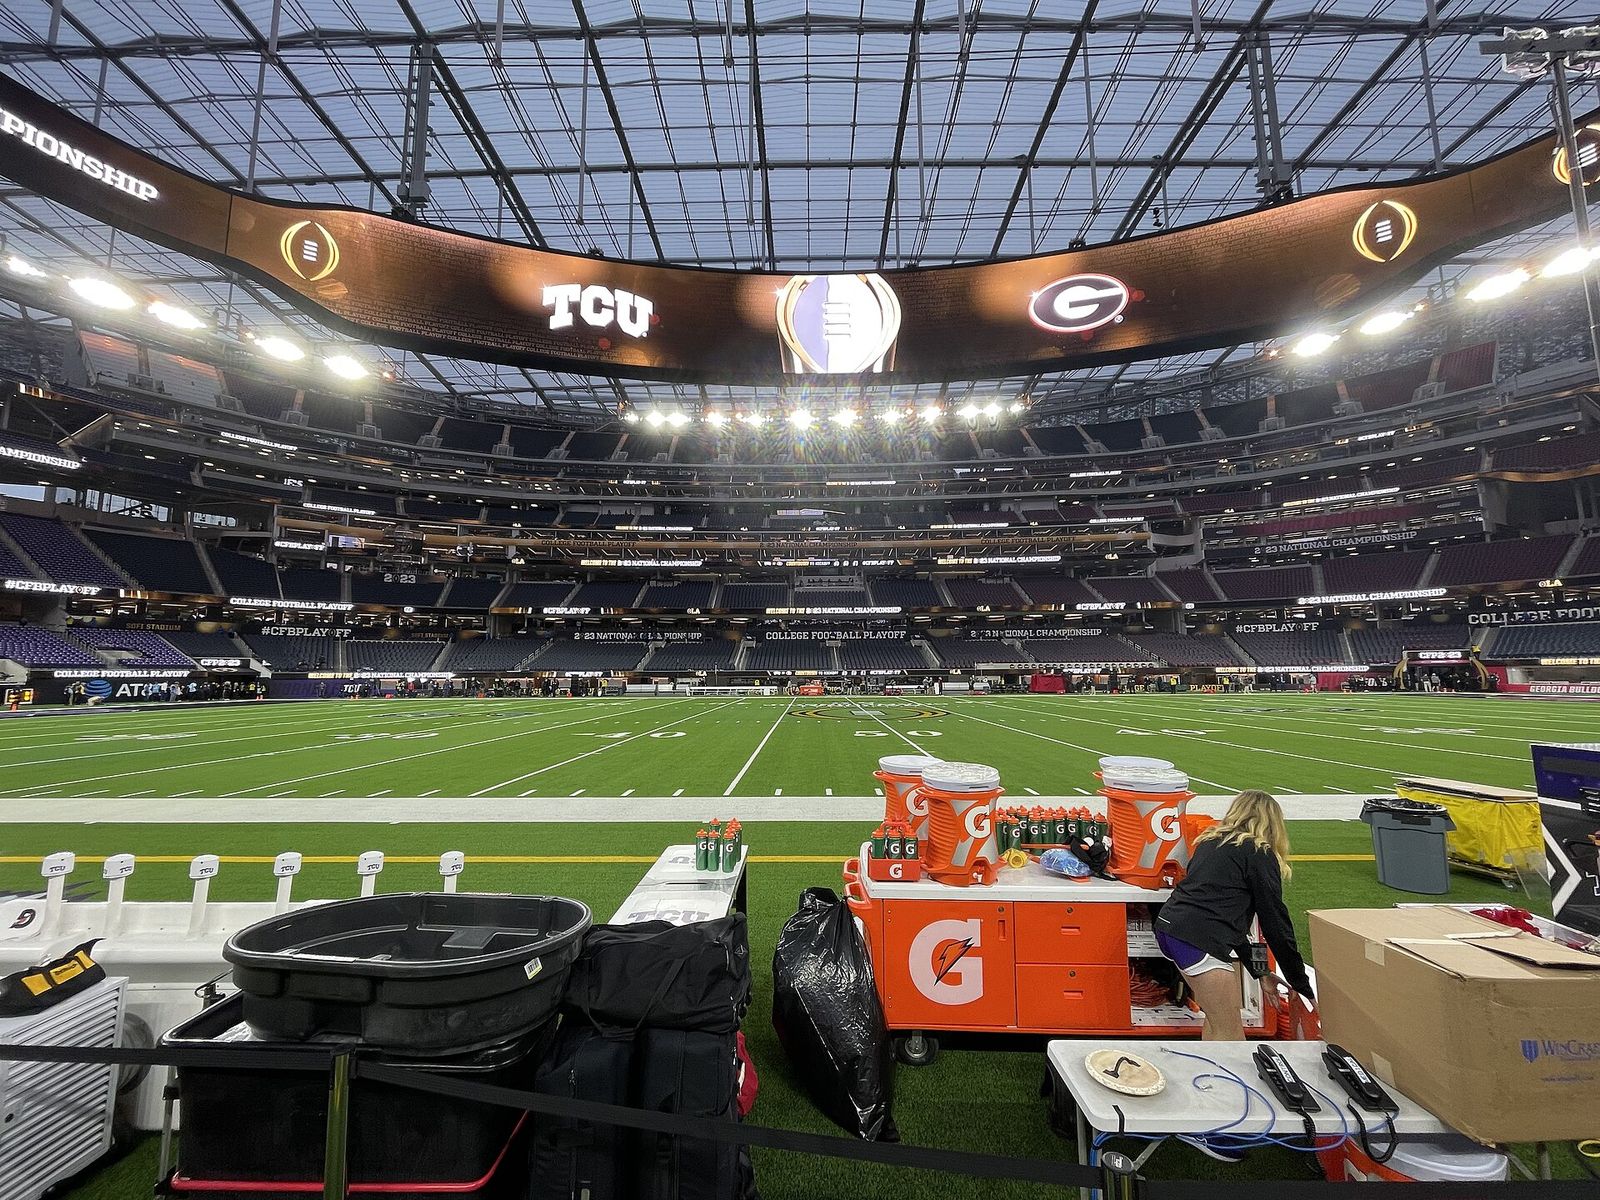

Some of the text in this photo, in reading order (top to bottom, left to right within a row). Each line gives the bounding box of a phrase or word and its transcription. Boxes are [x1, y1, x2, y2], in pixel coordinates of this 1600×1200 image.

[0, 107, 160, 203] PIONSHIP
[542, 283, 654, 339] TCU
[1279, 541, 1331, 552] NATIONAL
[1333, 531, 1417, 548] CHAMPIONSHIP
[5, 580, 101, 596] #CFBPLAYOFF
[1322, 593, 1369, 604] NATIONAL
[1370, 588, 1447, 601] CHAMPIONSHIP
[230, 597, 354, 611] COLLEGE FOOTBALL PLAYOFF
[146, 623, 181, 631] STADIUM
[262, 626, 351, 638] #CFBPLAYOFF
[1236, 622, 1319, 634] #CFBPLAYOFF
[596, 632, 636, 640] NATIONA
[640, 632, 702, 640] CPIONSHIP
[766, 631, 809, 640] COLLEGE
[863, 631, 907, 640] PLAYOFF
[992, 629, 1034, 638] NIONAL
[1036, 628, 1102, 637] CHAMPIONSHIP
[54, 670, 190, 678] COLLEGE FOOTBALL PLAYOFF
[115, 683, 166, 697] AT
[343, 684, 361, 693] TCU
[1530, 685, 1568, 693] GEORGIA
[906, 788, 929, 817] G
[964, 804, 990, 838] G
[1019, 821, 1027, 830] G
[1151, 807, 1181, 841] G
[1012, 828, 1021, 838] G
[1030, 825, 1039, 835] G
[1056, 824, 1065, 834] G
[1067, 823, 1076, 833] G
[700, 841, 707, 850] G
[708, 842, 715, 850] G
[726, 843, 734, 853] G
[890, 844, 901, 854] G
[905, 843, 915, 854] G
[50, 865, 66, 873] TCU
[119, 865, 132, 874] TCU
[199, 867, 214, 875] TCU
[367, 863, 380, 871] TCU
[889, 864, 903, 878] G
[627, 910, 710, 923] TCU
[908, 918, 984, 1006] G
